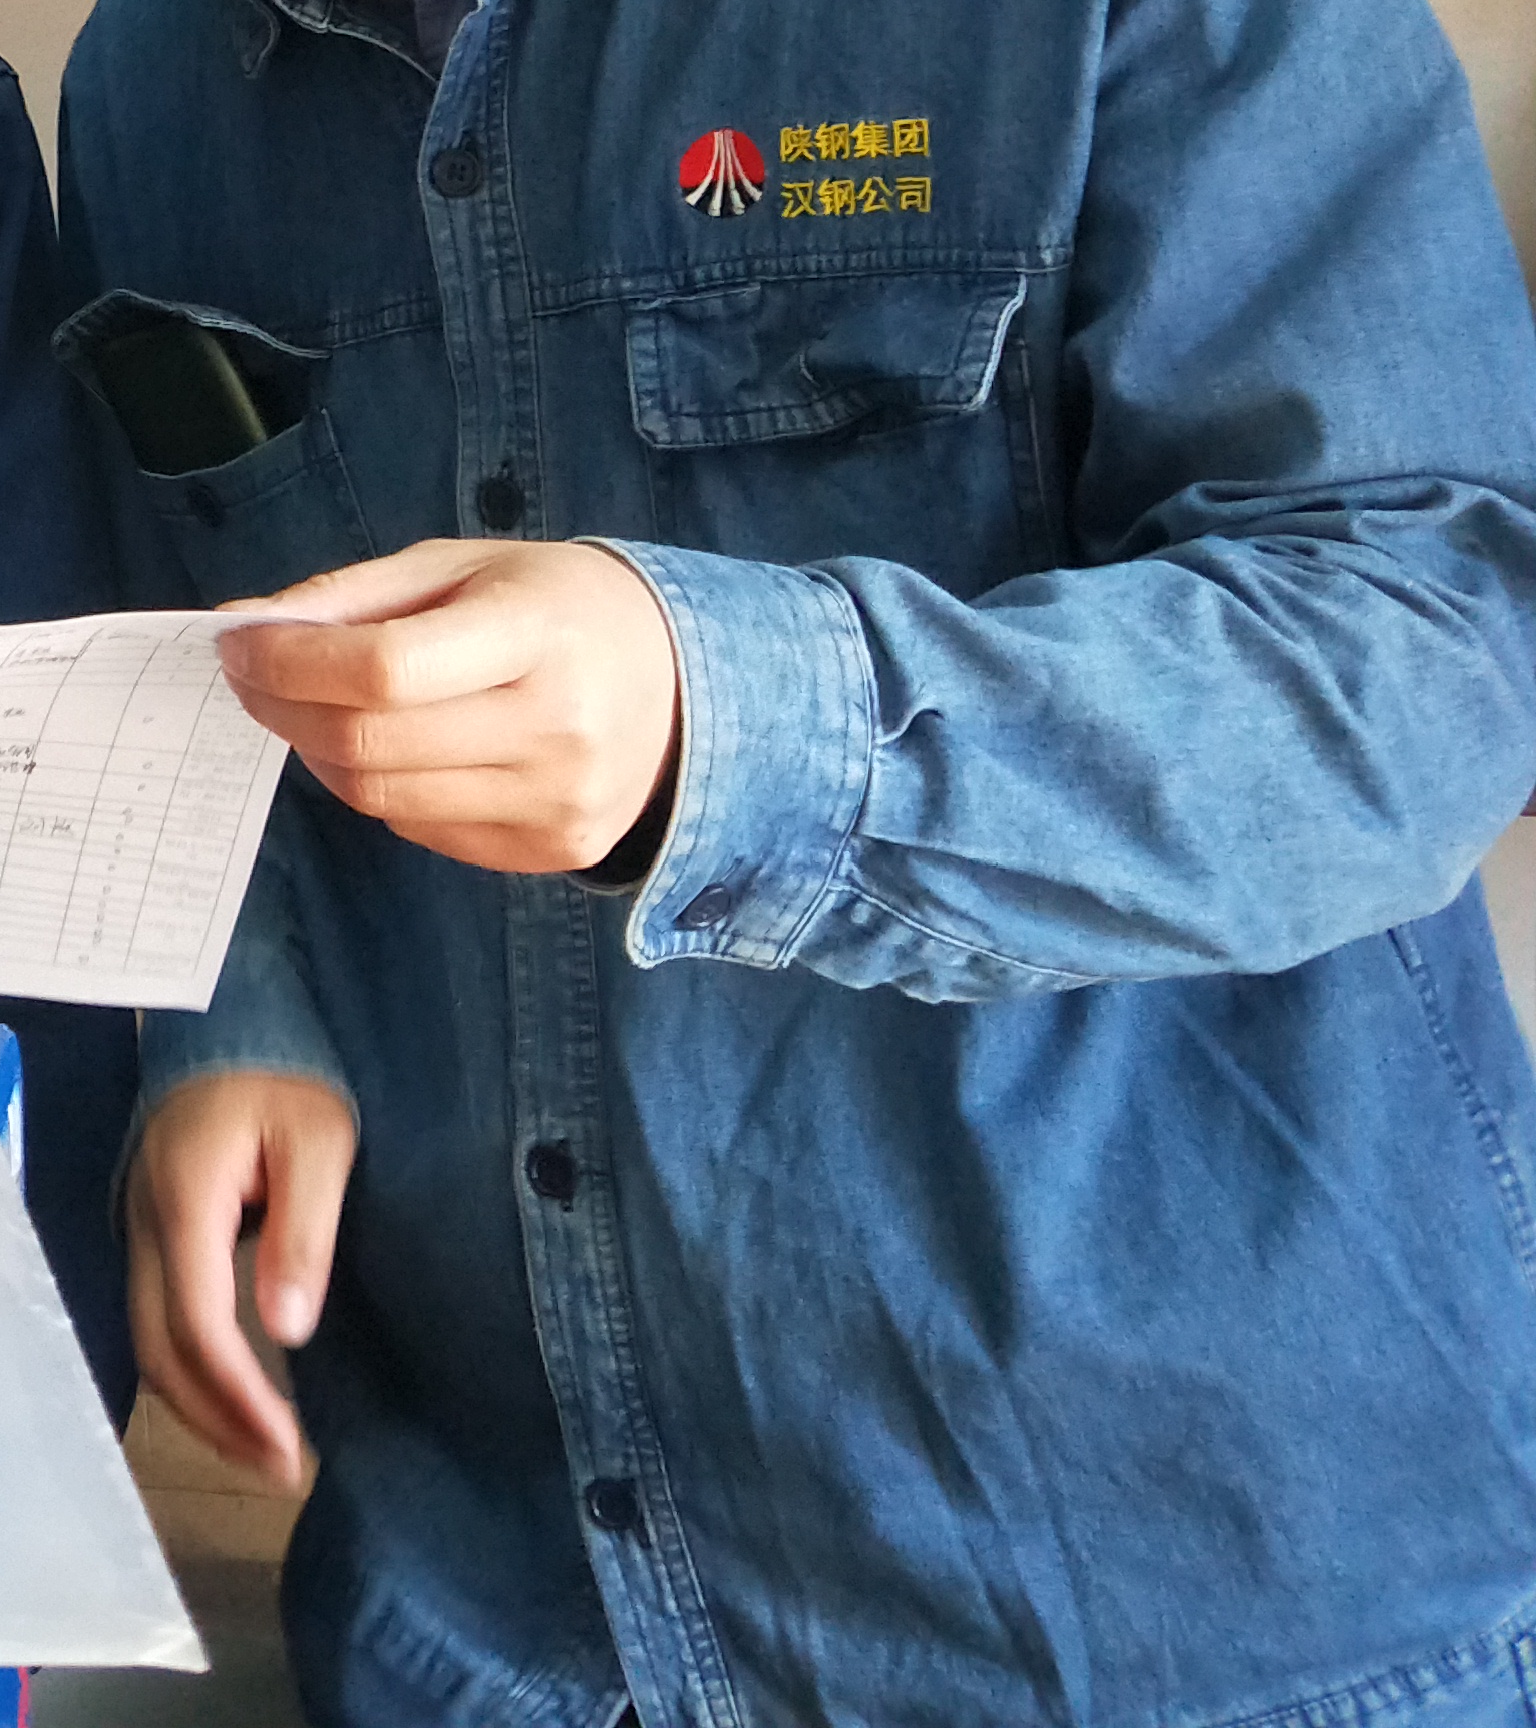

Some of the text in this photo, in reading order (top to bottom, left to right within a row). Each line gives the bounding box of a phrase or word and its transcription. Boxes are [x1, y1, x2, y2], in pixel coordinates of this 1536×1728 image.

[779, 119, 930, 163] 陕钢集团
[780, 176, 932, 219] 汉钢公司
